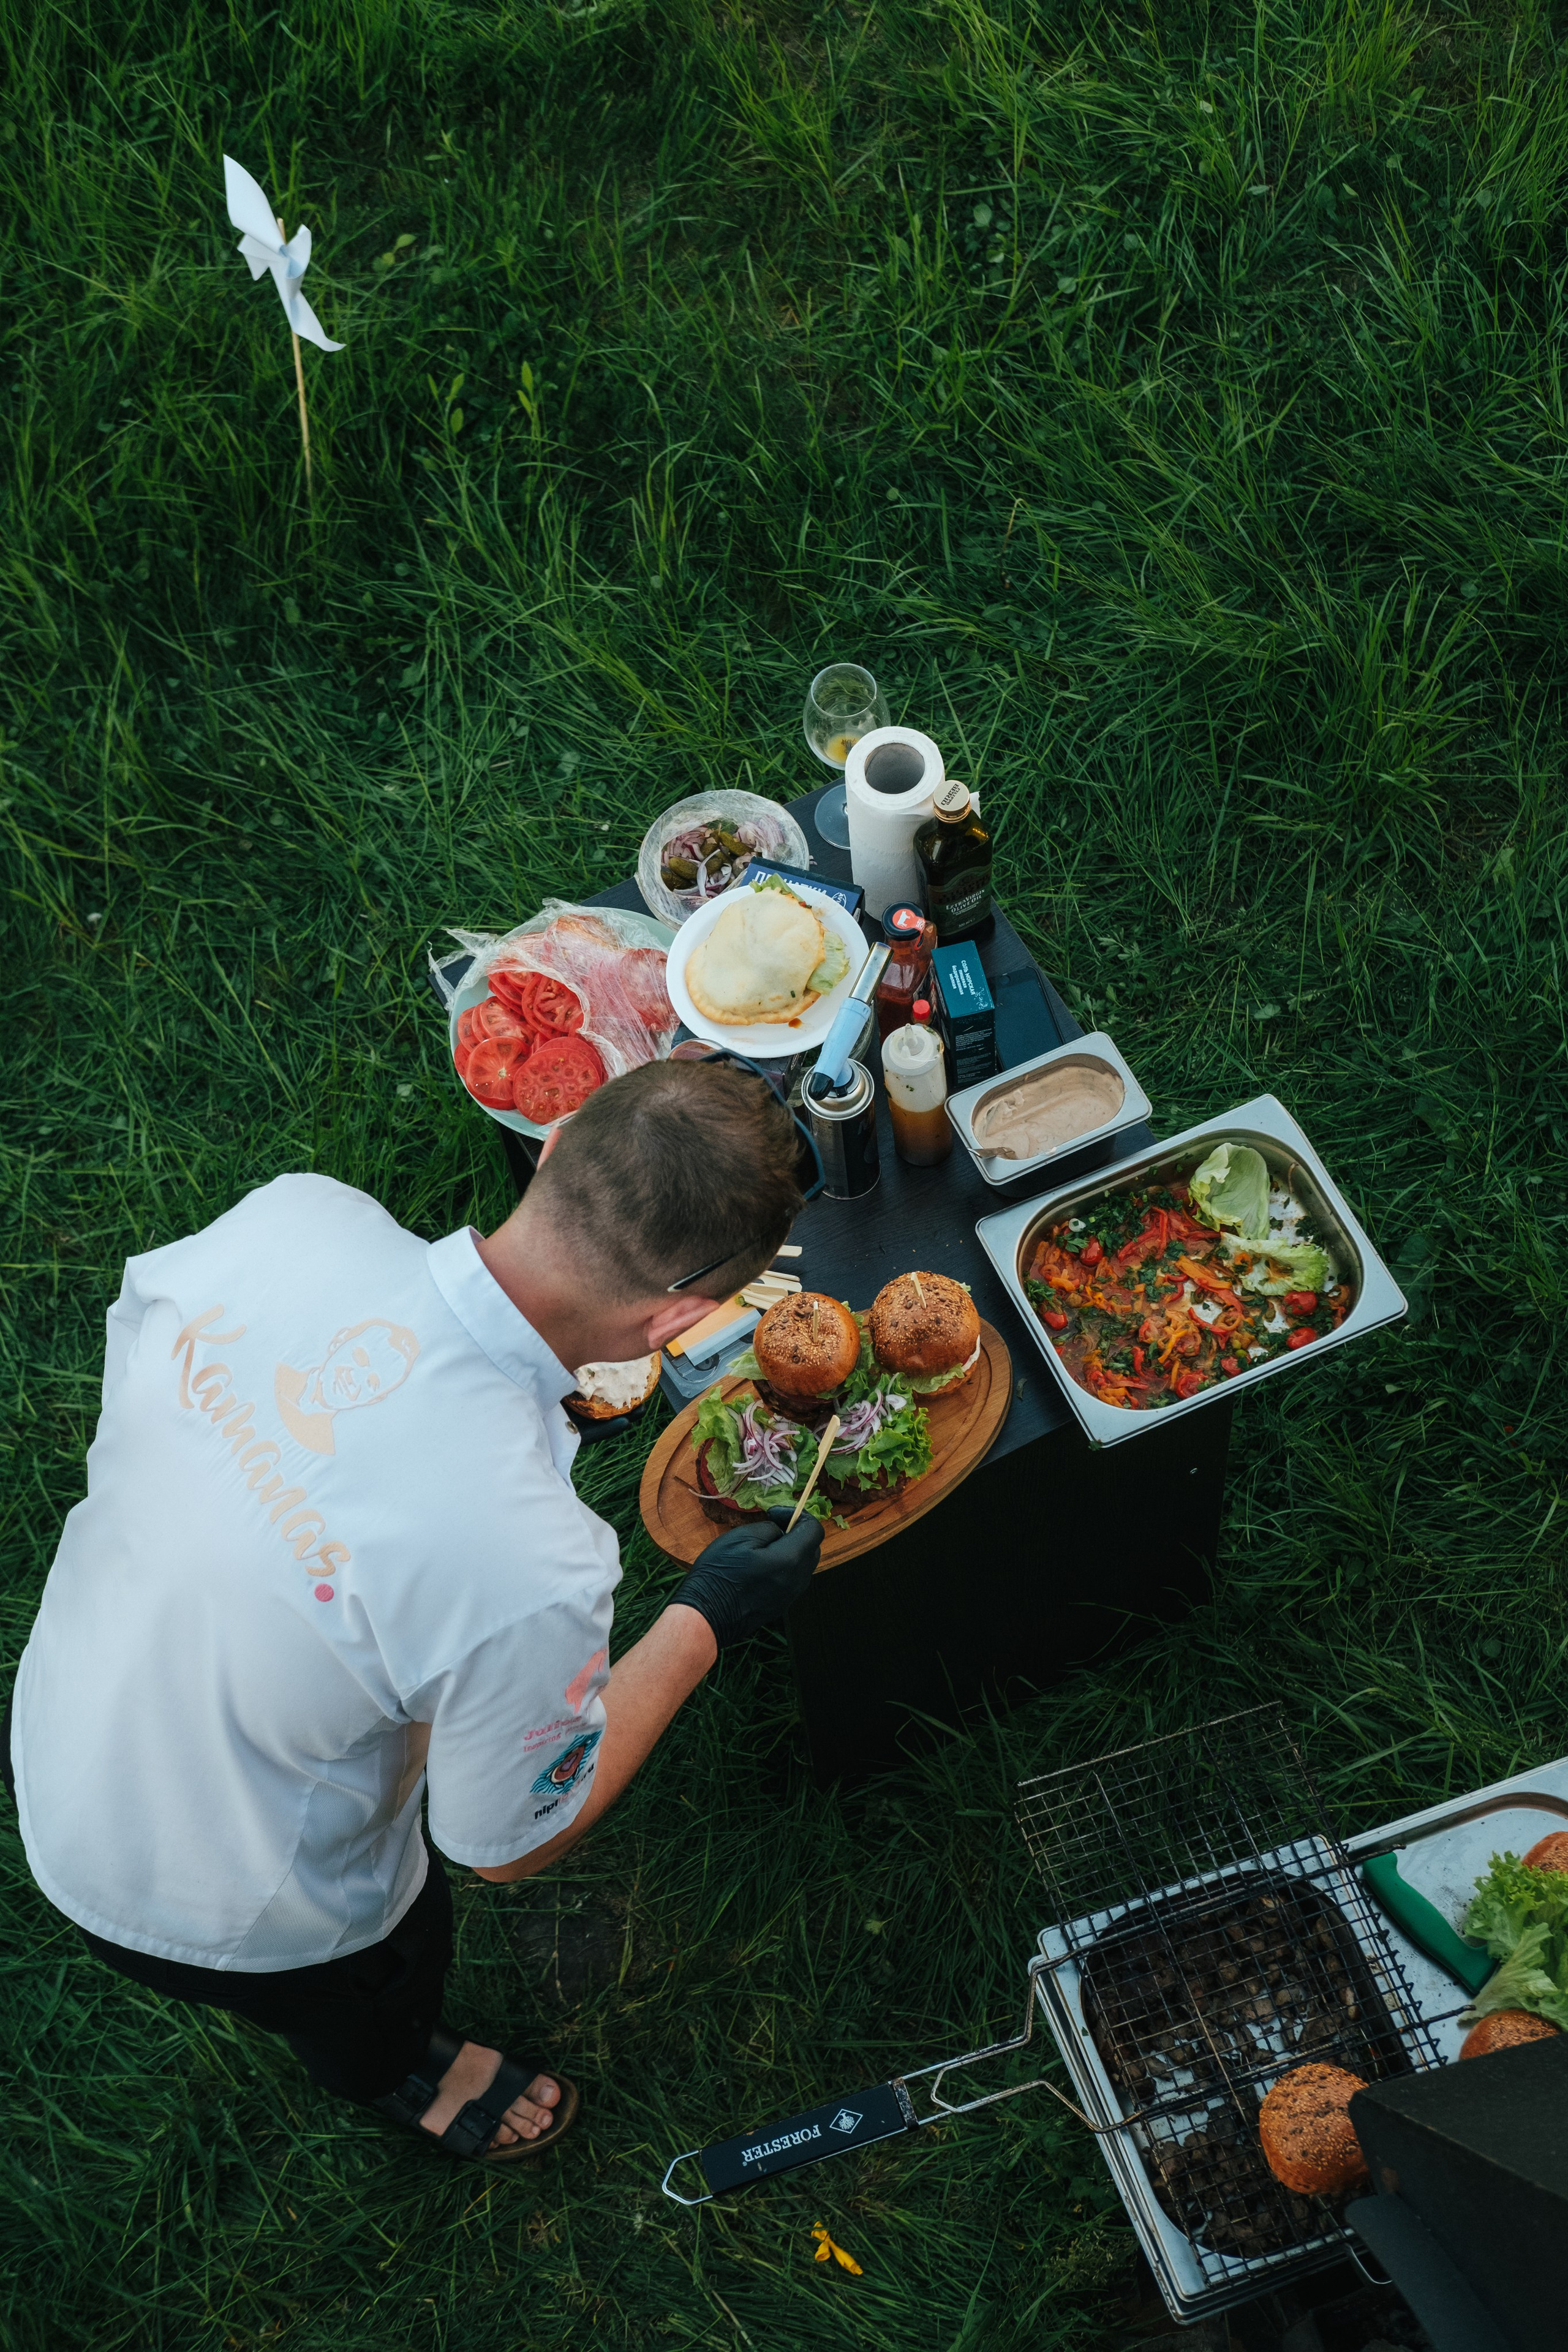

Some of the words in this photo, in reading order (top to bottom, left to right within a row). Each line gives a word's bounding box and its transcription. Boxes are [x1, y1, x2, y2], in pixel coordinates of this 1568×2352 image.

[941, 783, 960, 805] BERIO
[951, 902, 971, 913] OLIVE
[971, 894, 982, 903] OIL
[965, 973, 976, 995] МОРСКАЯ
[741, 2124, 822, 2163] FORESTER
